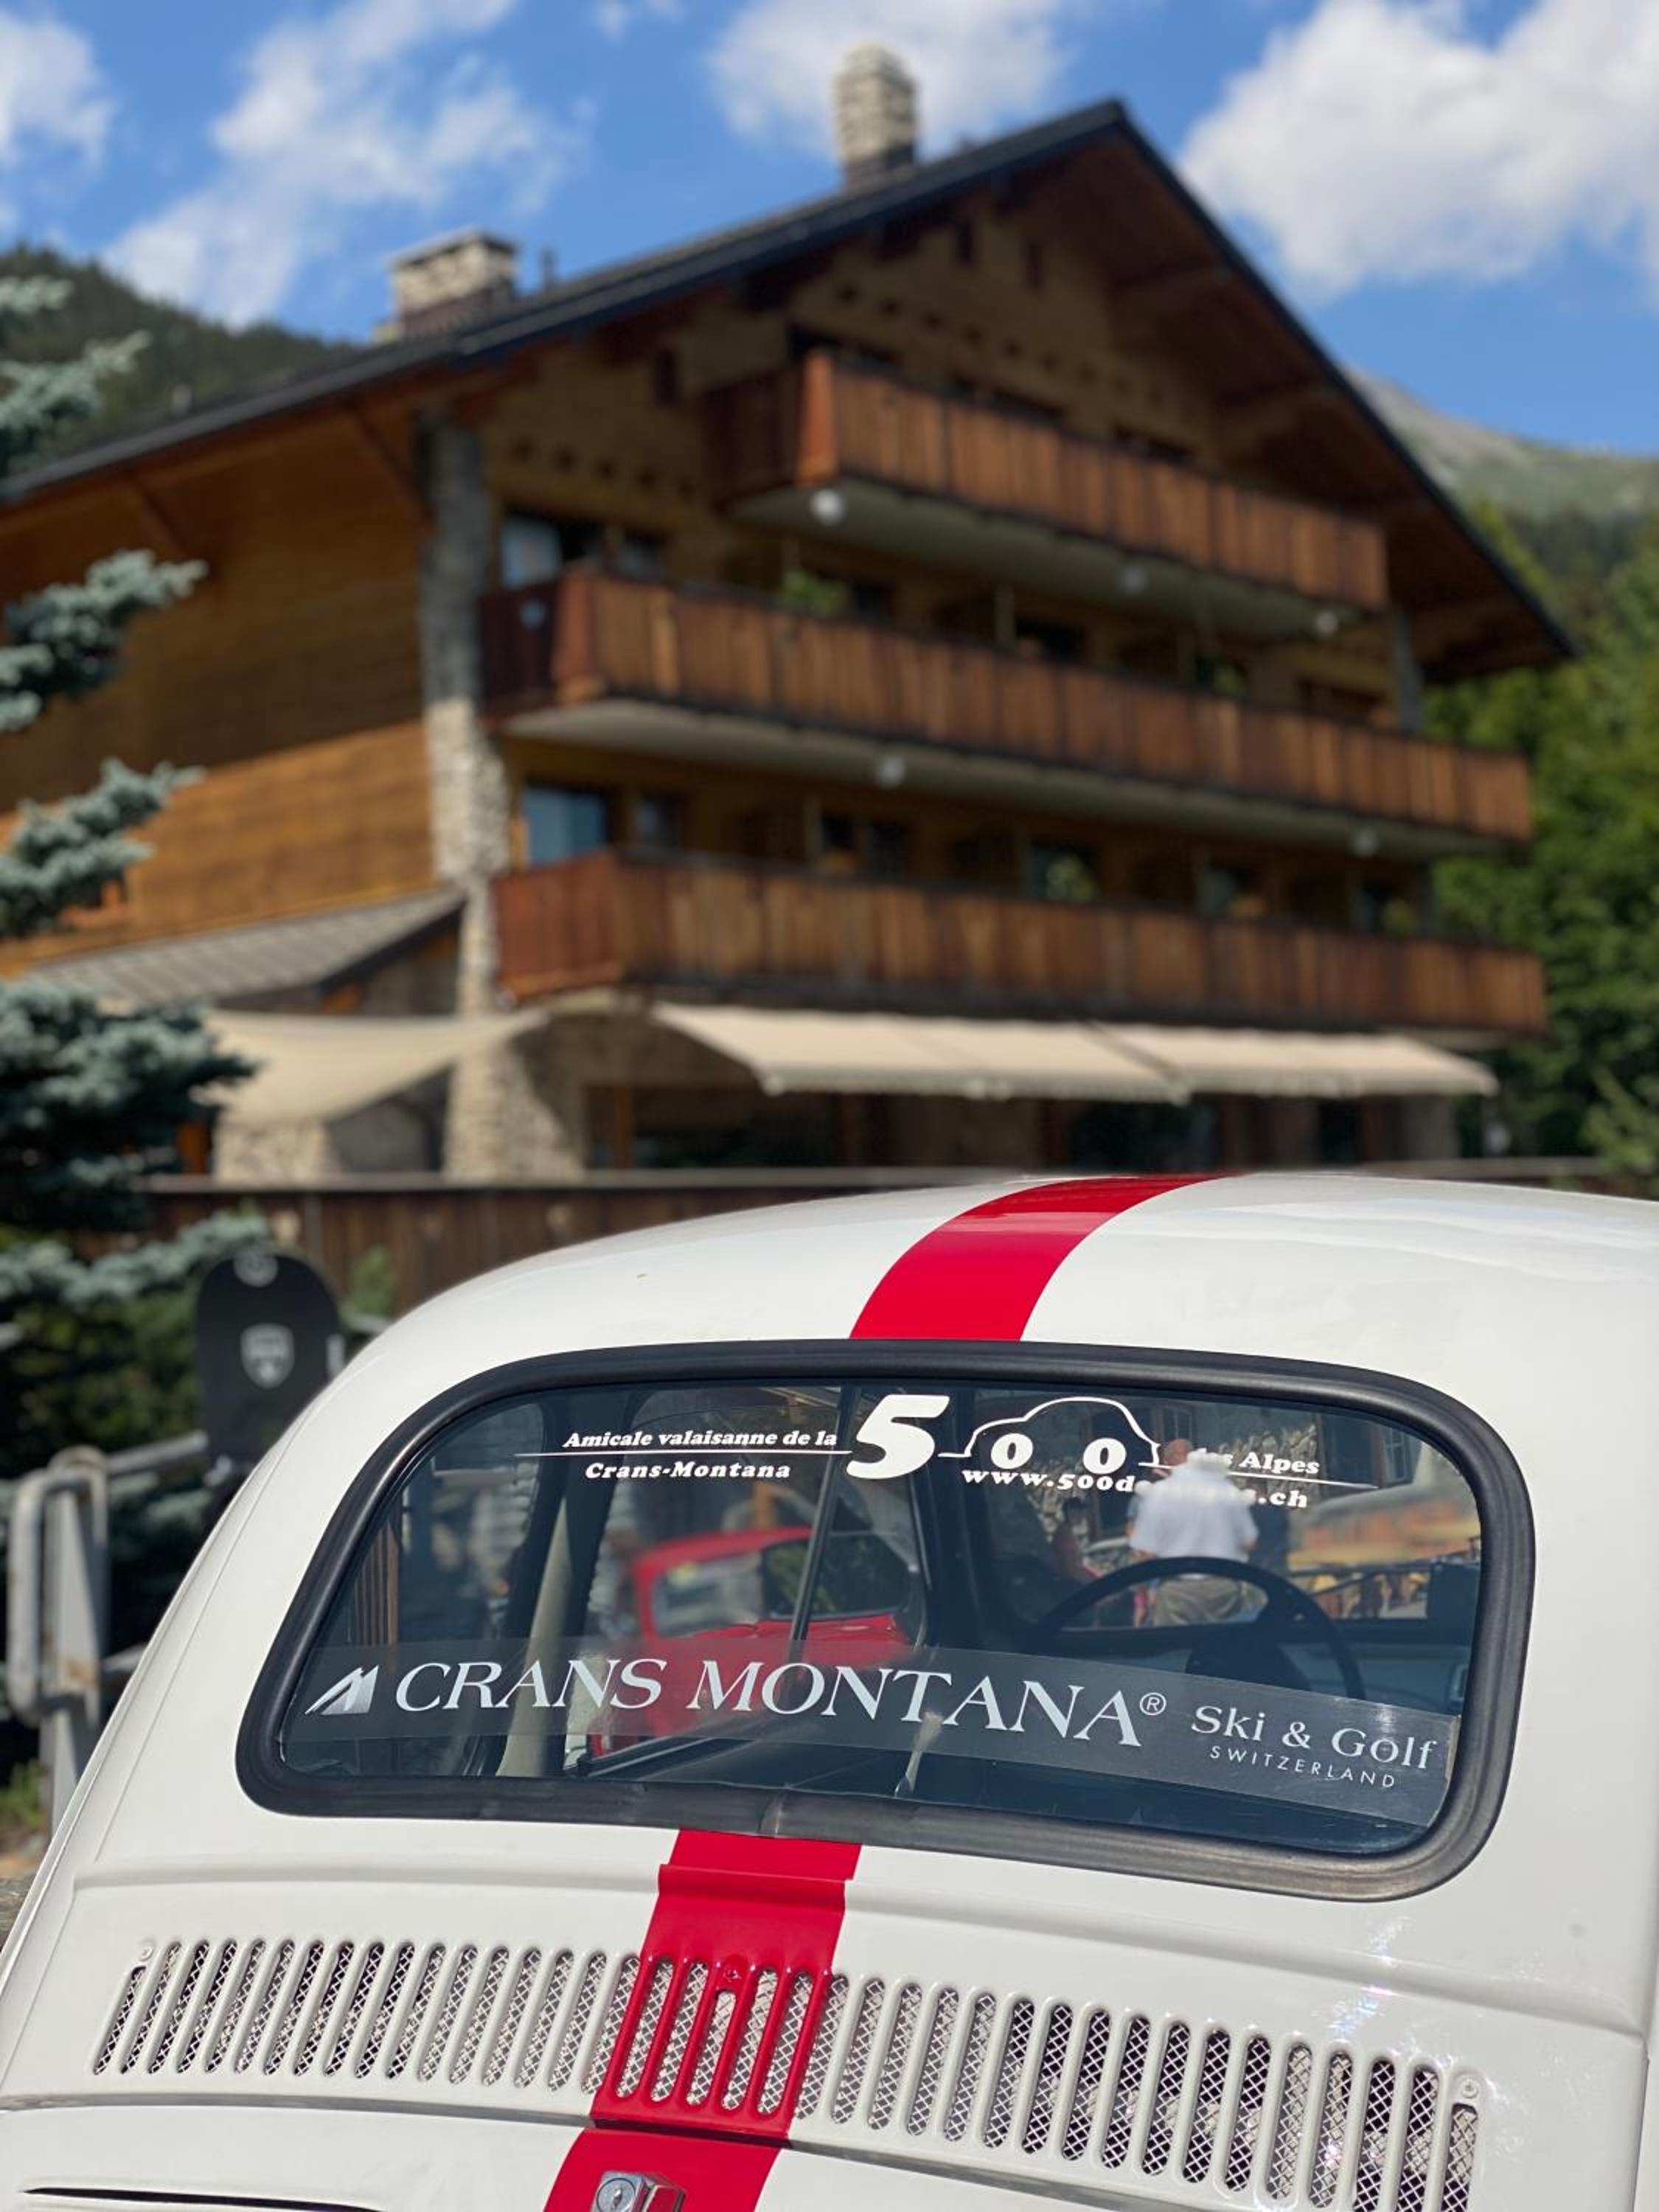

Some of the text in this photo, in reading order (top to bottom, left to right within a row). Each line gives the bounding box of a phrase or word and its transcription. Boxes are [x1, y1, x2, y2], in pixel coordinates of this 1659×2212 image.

[562, 1430, 653, 1447] Amicale
[658, 1430, 777, 1447] valaisanne
[782, 1430, 810, 1446] de
[815, 1430, 837, 1446] la
[1239, 1451, 1321, 1475] Alpes
[585, 1461, 790, 1479] Crans-Montana
[394, 1658, 666, 1711] CRANS
[1191, 1705, 1437, 1770] Ski & Golf
[1209, 1745, 1394, 1788] SWITZERLAND
